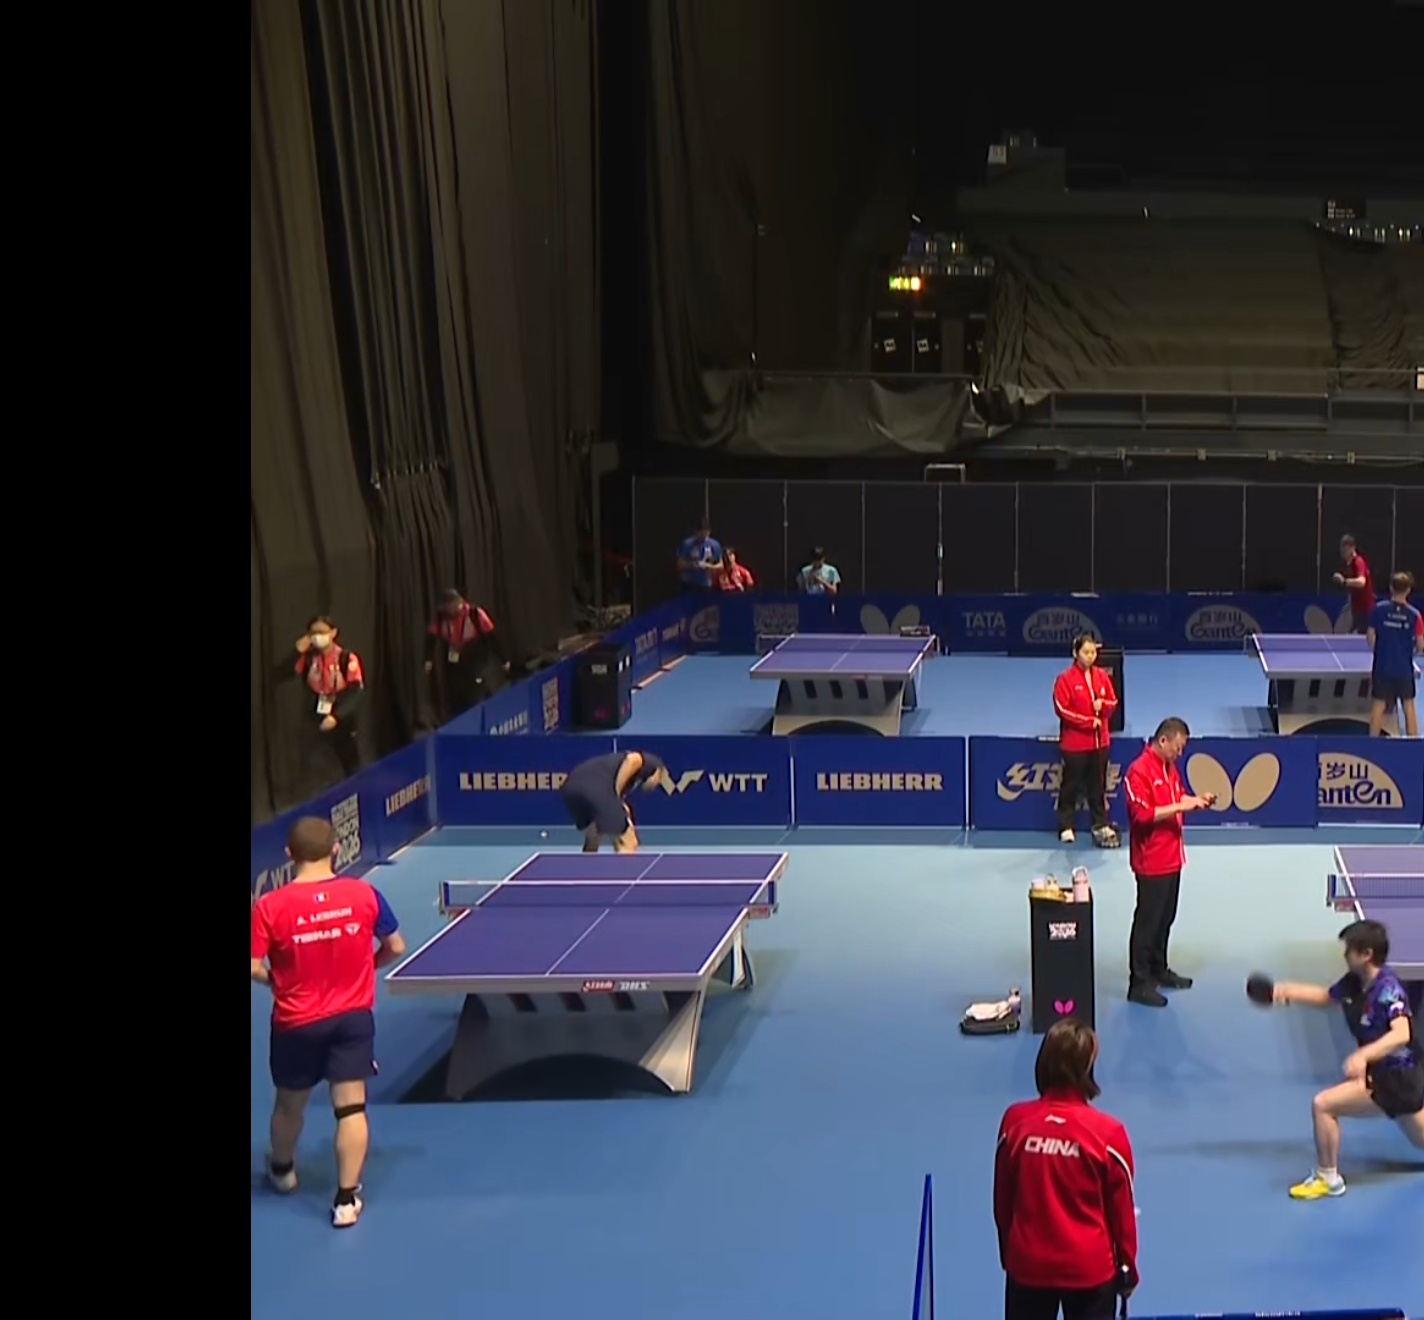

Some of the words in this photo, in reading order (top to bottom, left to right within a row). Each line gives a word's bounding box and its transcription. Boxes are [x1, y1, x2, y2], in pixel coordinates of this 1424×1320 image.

[1318, 761, 1368, 780] 岁山
[708, 773, 767, 793] WTT
[816, 772, 943, 791] LIEBHERR
[1025, 1135, 1080, 1158] CHINA
